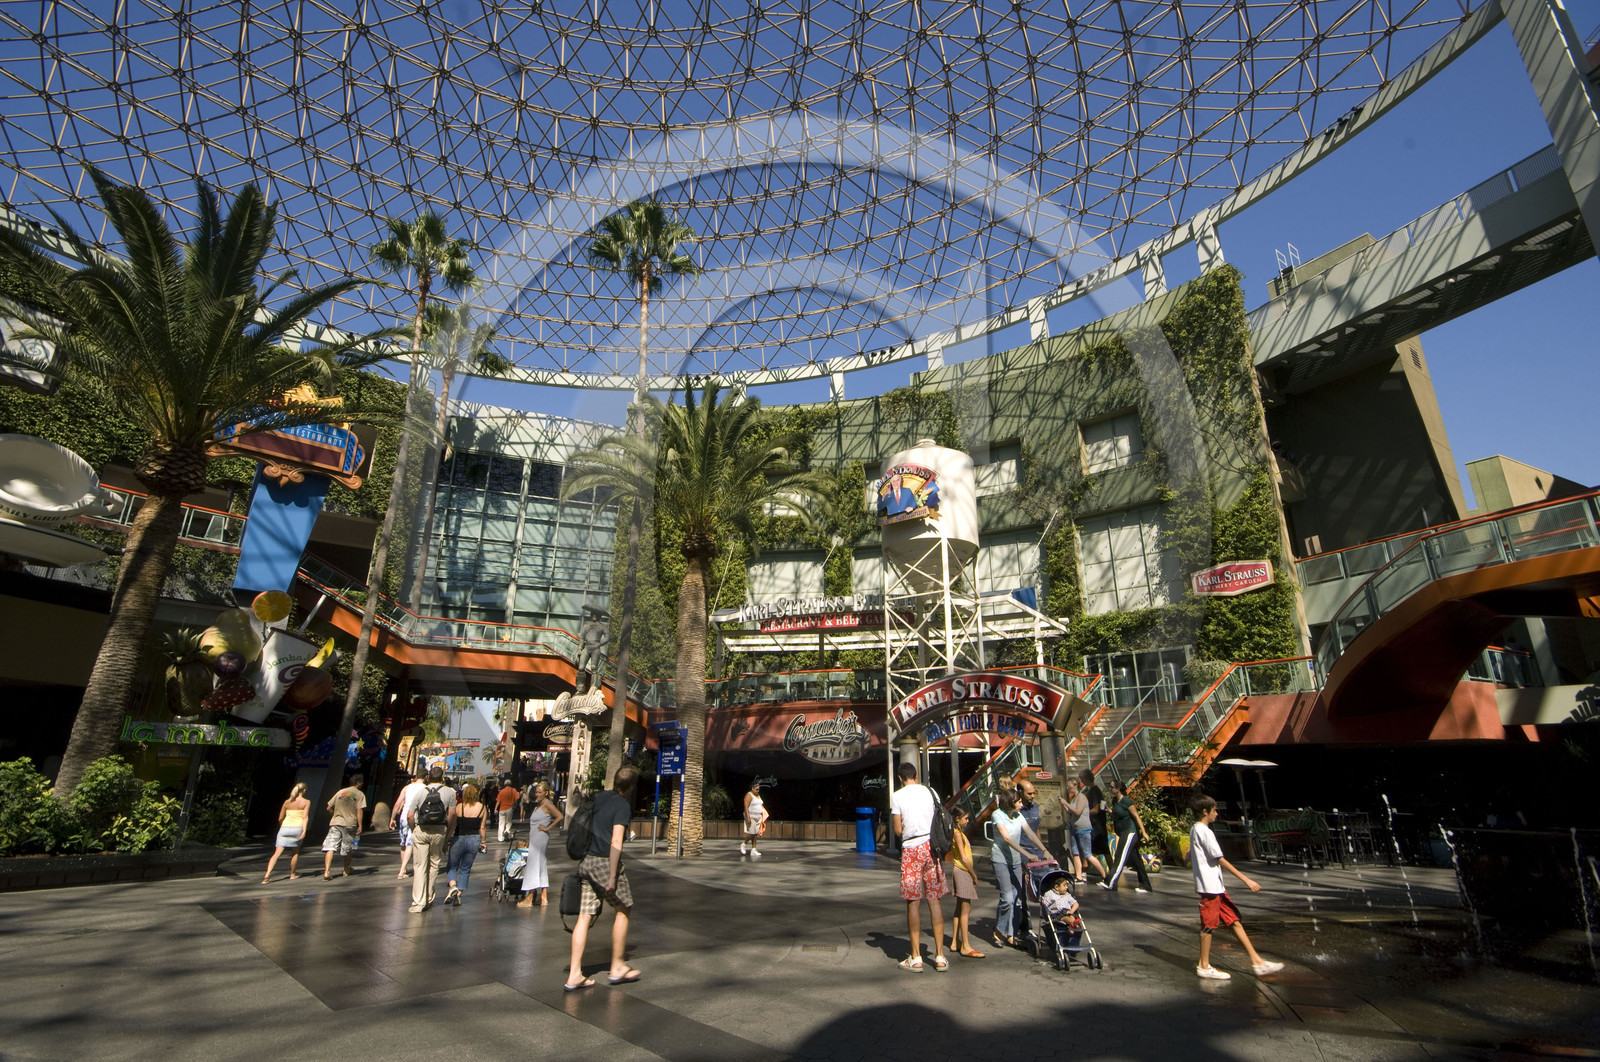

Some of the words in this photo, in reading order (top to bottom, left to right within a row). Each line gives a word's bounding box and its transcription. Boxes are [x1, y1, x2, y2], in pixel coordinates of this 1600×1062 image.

[290, 427, 343, 447] RESTAURANT
[1197, 574, 1224, 587] KARL
[1223, 567, 1266, 583] STRAUSS
[1203, 583, 1232, 591] BREWERY
[1234, 578, 1262, 587] GARDEN
[739, 603, 773, 623] KARL
[776, 596, 846, 618] STRAUSS
[764, 617, 821, 632] RESTAURANT
[824, 617, 833, 626] &
[835, 614, 864, 626] BEER
[897, 687, 948, 724] KARL
[951, 678, 1046, 713] STRAUSS
[925, 717, 955, 743] GREAT
[959, 713, 984, 731] FOOD
[986, 714, 995, 730] &
[997, 714, 1027, 738] BEER
[802, 747, 860, 759] CANTINA
